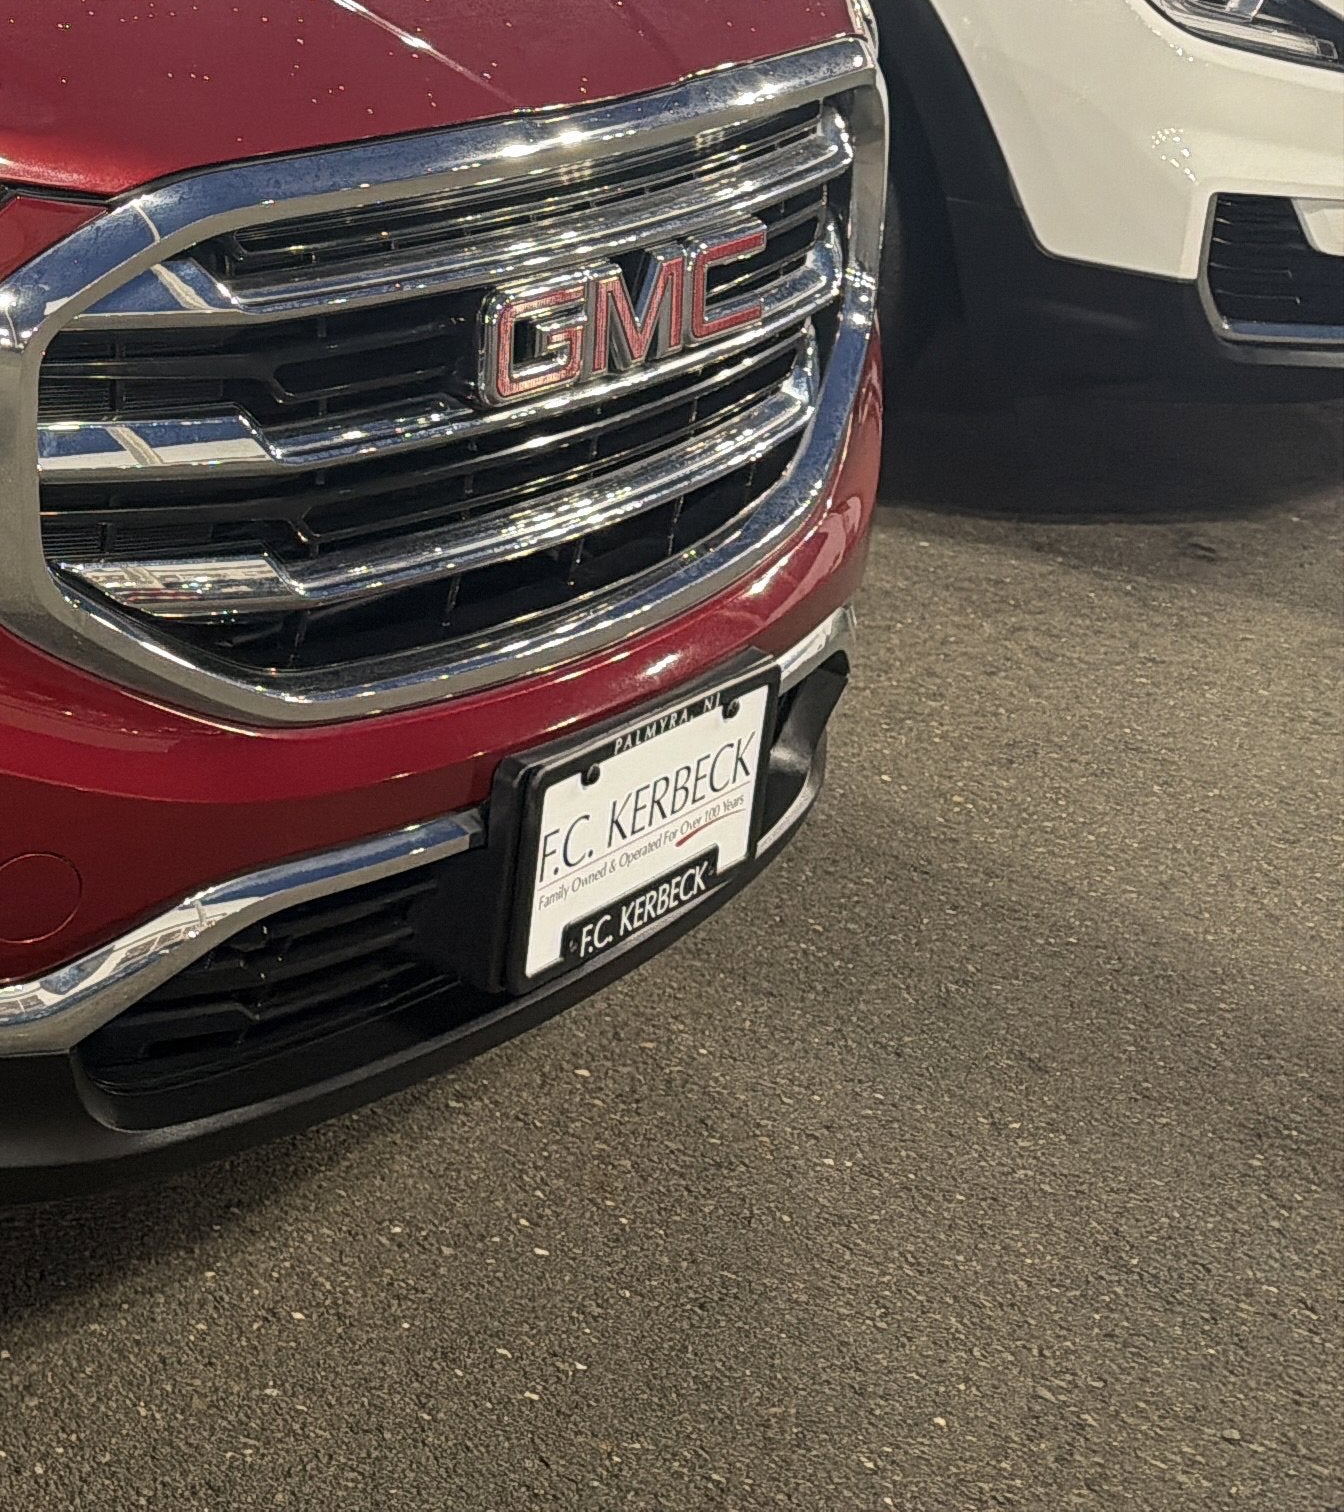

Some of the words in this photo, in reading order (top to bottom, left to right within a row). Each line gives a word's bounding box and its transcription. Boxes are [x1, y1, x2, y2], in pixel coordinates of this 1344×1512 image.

[479, 218, 767, 406] GMC
[613, 707, 695, 756] PALMYRA,
[537, 884, 568, 911] Family
[571, 864, 607, 894] Owned
[608, 860, 616, 874] &
[618, 836, 662, 869] Operated
[663, 828, 679, 846] For
[679, 817, 702, 837] Over
[704, 804, 721, 822] 100
[722, 794, 745, 814] Years
[538, 813, 594, 883] F.C.
[606, 730, 756, 849] KERBECK
[579, 914, 614, 958] F.C.
[618, 860, 709, 936] KERBECK
